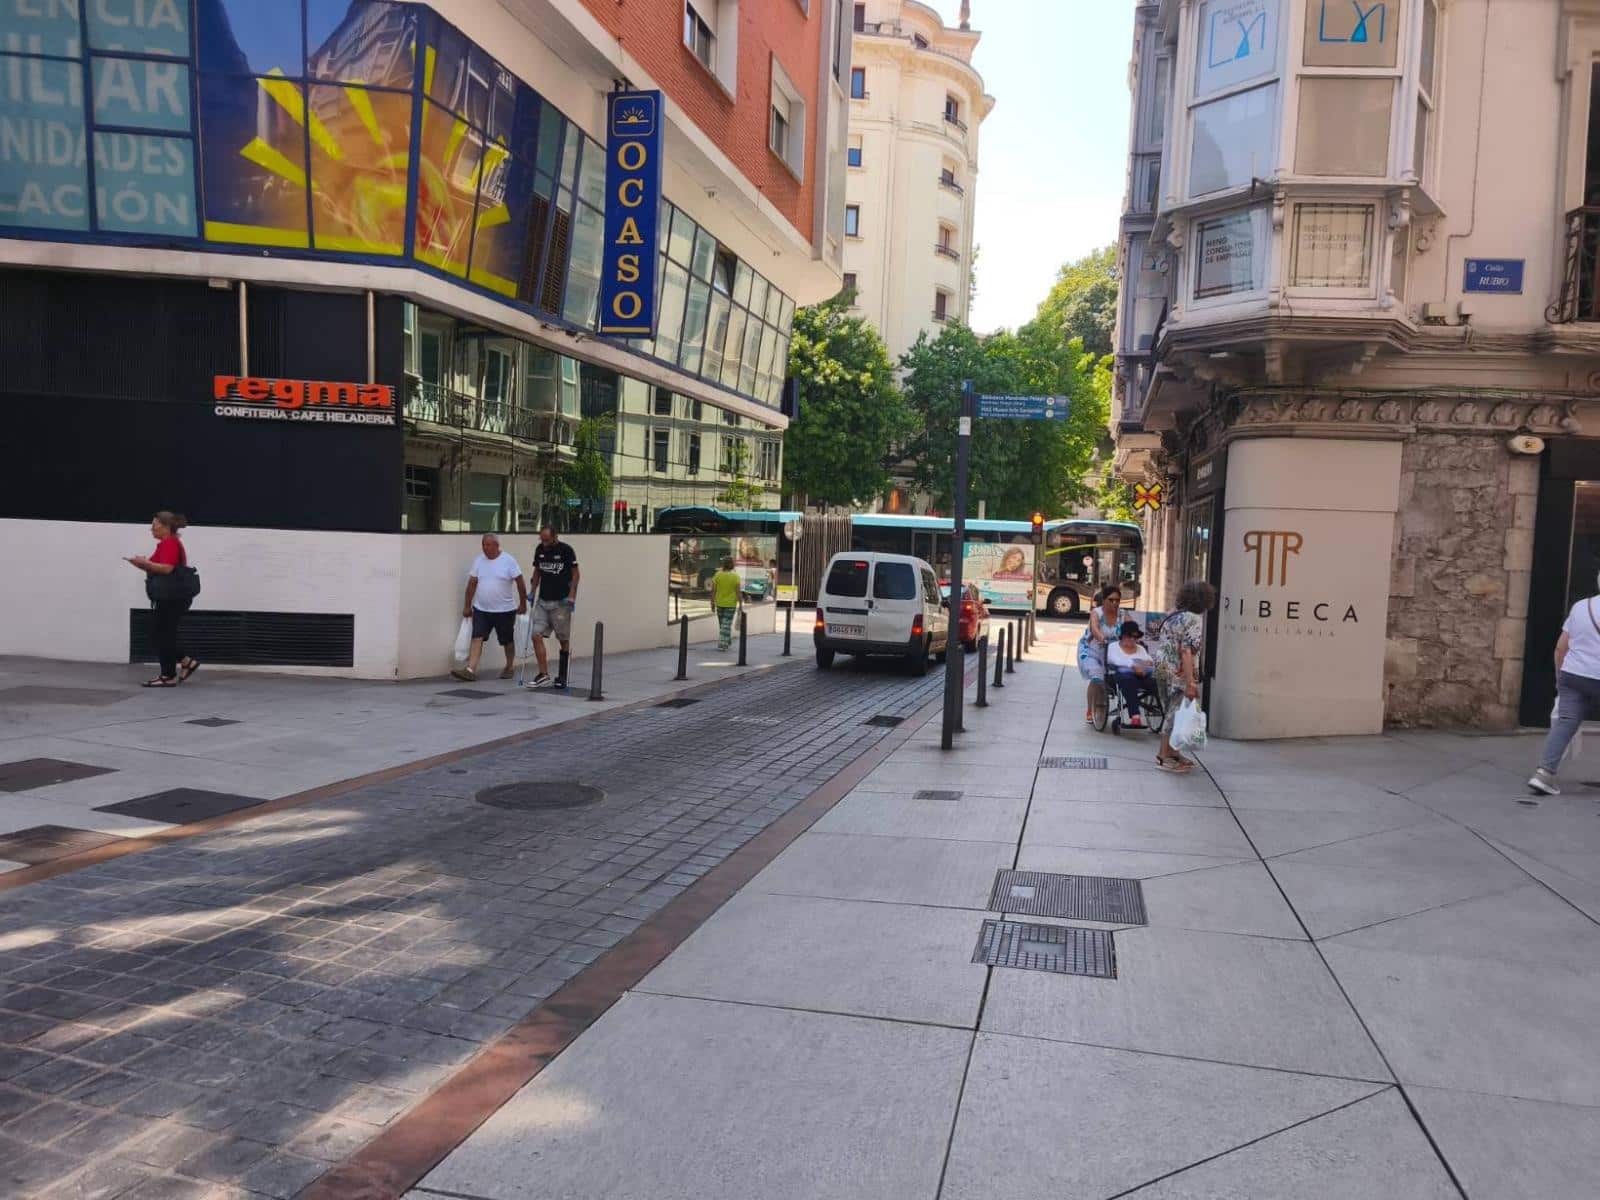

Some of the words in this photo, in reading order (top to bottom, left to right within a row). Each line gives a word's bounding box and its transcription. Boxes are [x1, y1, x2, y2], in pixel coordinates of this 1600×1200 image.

[612, 141, 647, 320] OCASO
[1480, 276, 1509, 286] RUBIO
[213, 375, 392, 409] regma
[214, 406, 288, 420] CONFITERIA
[291, 411, 324, 421] CAFE
[326, 413, 395, 425] HELADERIA
